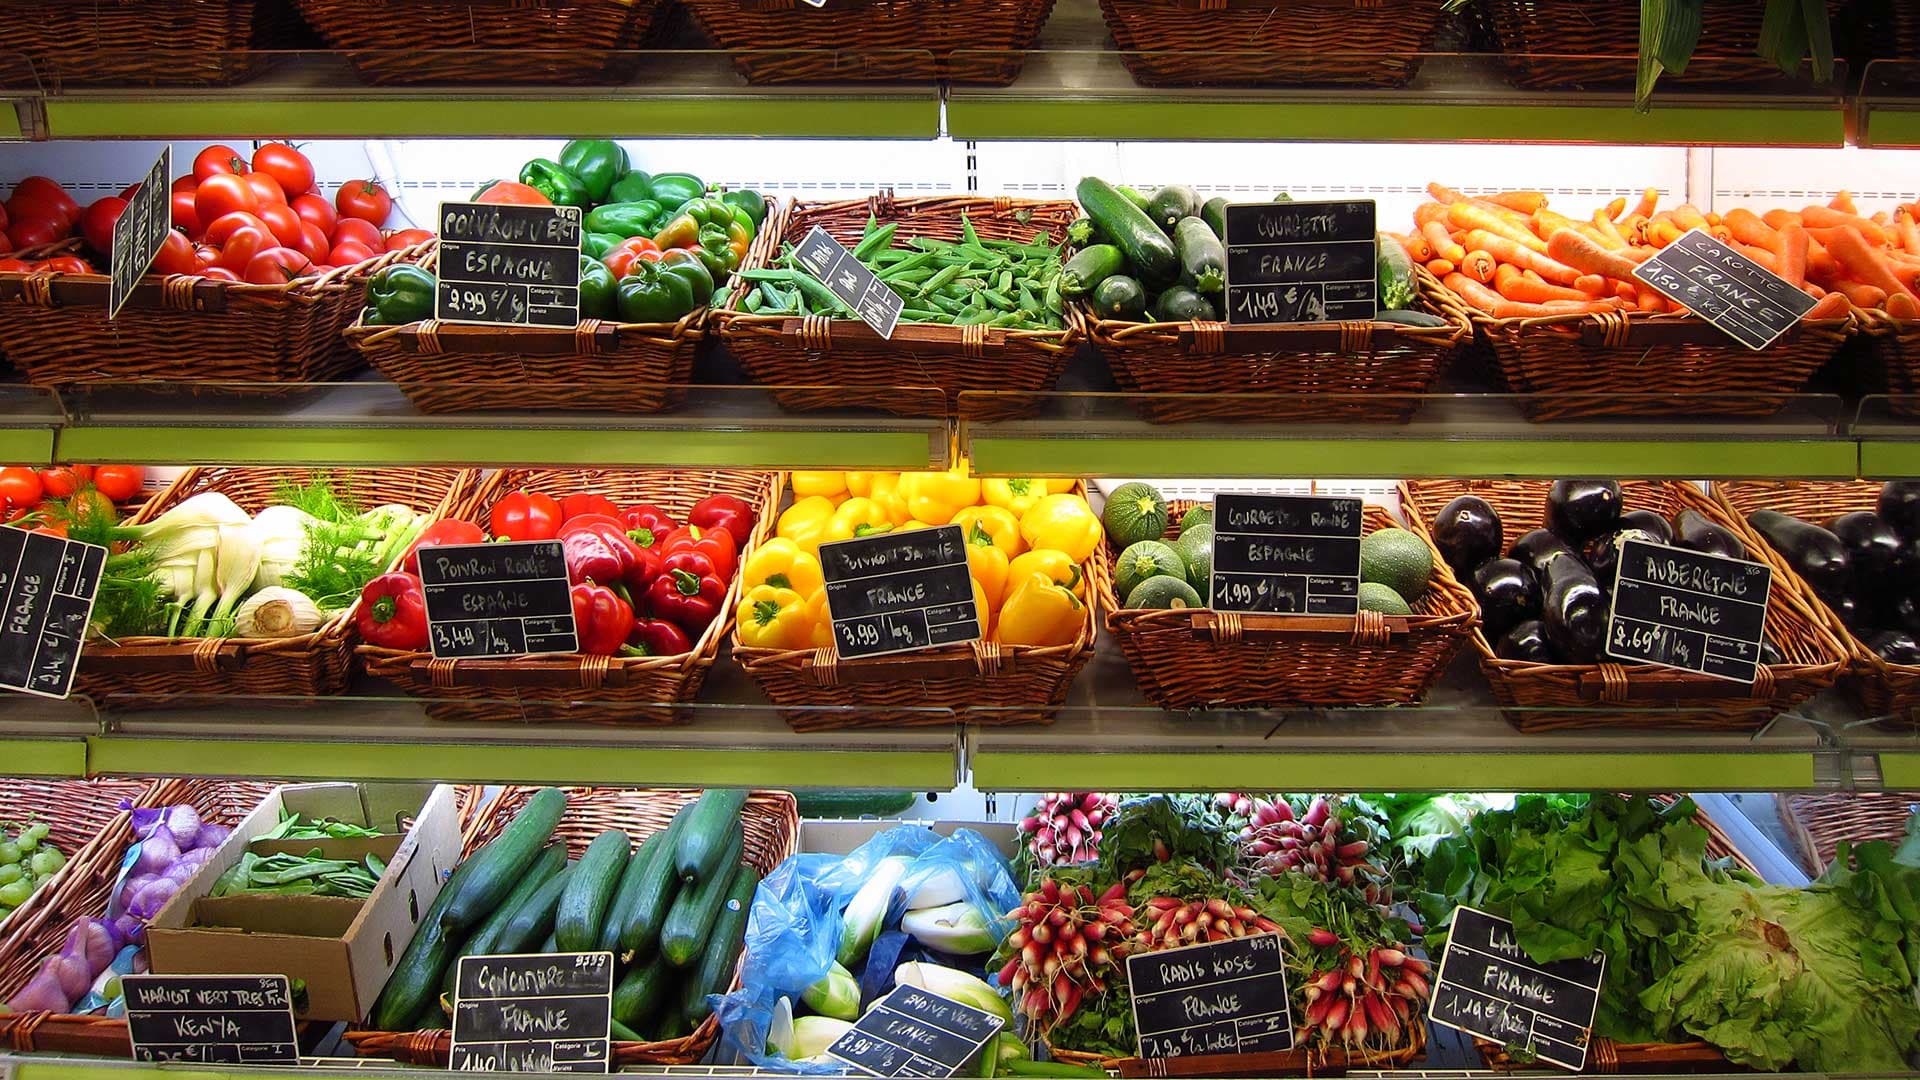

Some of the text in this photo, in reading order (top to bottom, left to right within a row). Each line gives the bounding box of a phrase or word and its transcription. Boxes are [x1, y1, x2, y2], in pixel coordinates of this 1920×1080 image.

[465, 250, 552, 281] ESPAGNE
[1260, 253, 1328, 273] FRANCE
[1695, 242, 1785, 293] CAROTTE
[1249, 544, 1315, 562] ESPAGNE
[436, 556, 548, 580] POIVRON ROUGE
[1647, 556, 1747, 595] AUBERGINE
[828, 583, 846, 591] Origine
[866, 583, 925, 607] FRANCE
[9, 574, 41, 635] FRANCE
[1660, 596, 1721, 625] FRANCE
[1450, 945, 1470, 956] Origine
[1160, 959, 1205, 985] RADIS
[1483, 965, 1554, 1004] FRANCE
[138, 987, 190, 1005] HARICOT
[196, 989, 229, 1005] VERT
[232, 989, 264, 1007] TRES
[1182, 994, 1241, 1021] FRANCE
[174, 1015, 241, 1039] KENYA
[501, 1003, 570, 1032] FRANCE
[1536, 1016, 1563, 1029] Catégorie
[886, 1020, 937, 1045] FRANCE
[555, 1043, 581, 1051] Catégorie
